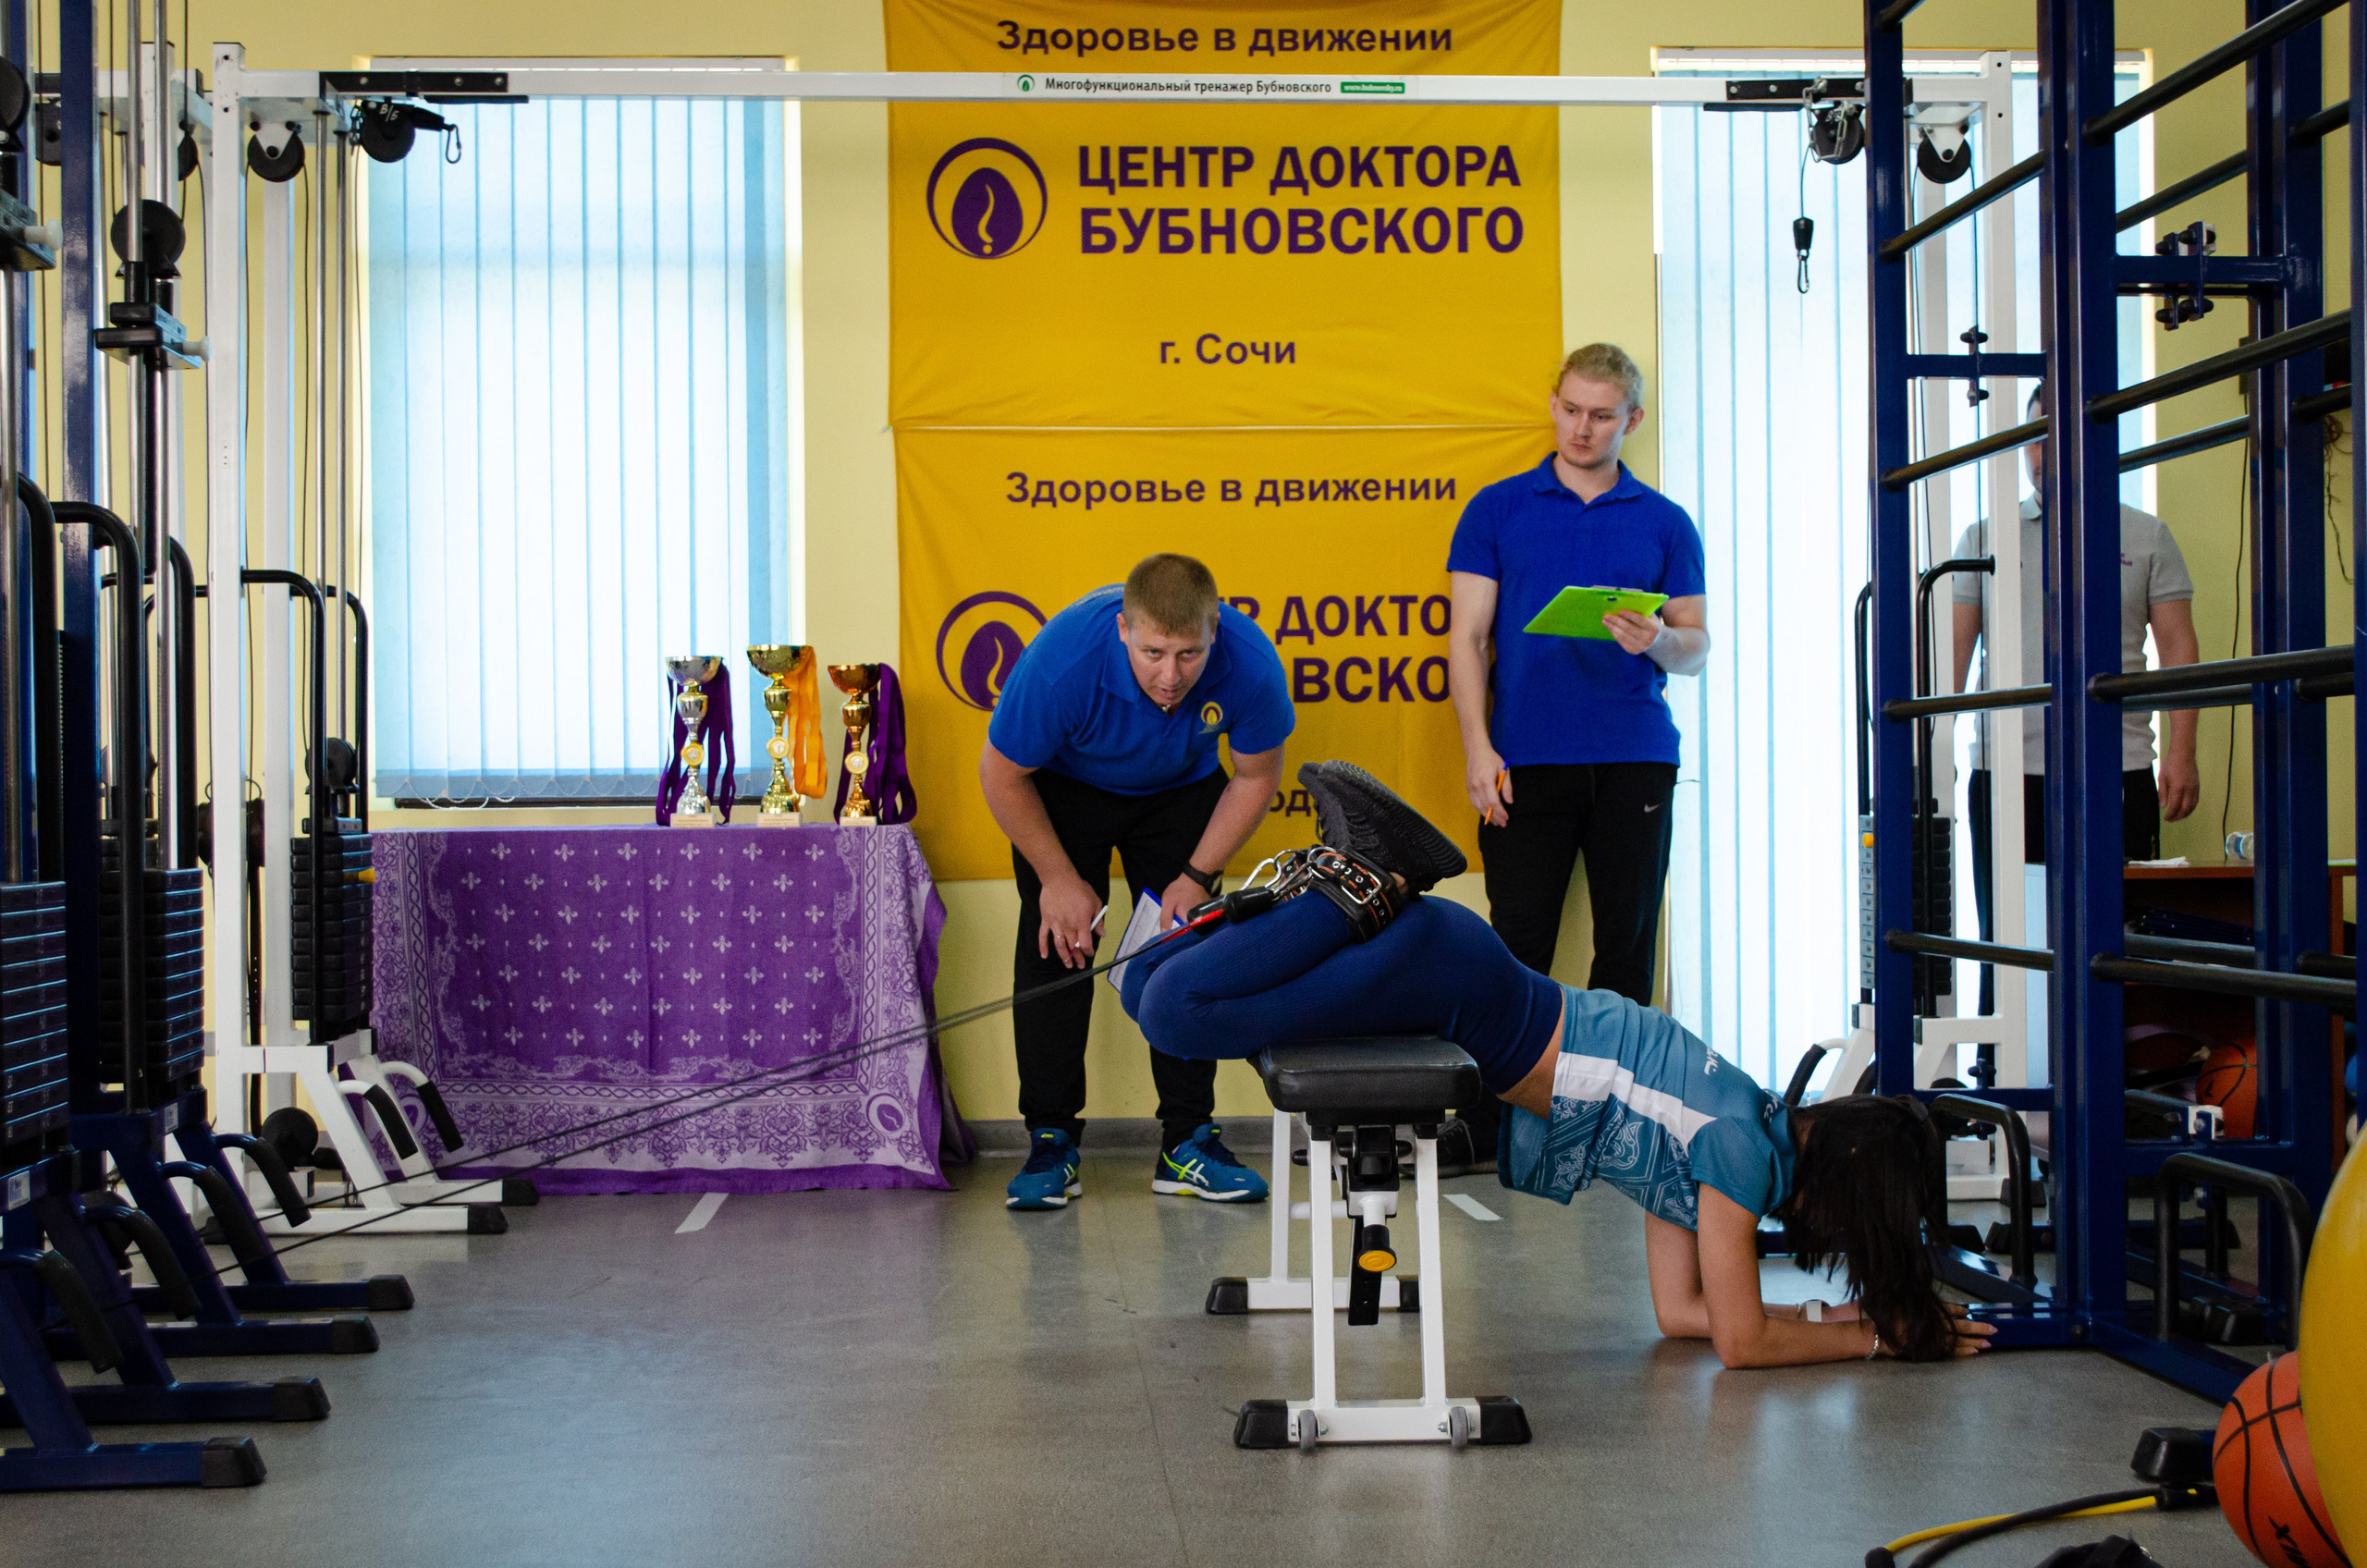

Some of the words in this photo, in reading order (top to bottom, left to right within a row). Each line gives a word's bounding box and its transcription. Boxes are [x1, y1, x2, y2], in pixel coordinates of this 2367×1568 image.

[997, 19, 1199, 57] Здоровье
[1214, 28, 1236, 52] в
[1248, 28, 1452, 56] движении
[1045, 77, 1191, 93] Многофункциональный
[1194, 81, 1254, 95] тренажер
[1256, 80, 1331, 95] Бубновского
[1079, 145, 1255, 196] ЦЕНТР
[1269, 144, 1521, 196] ДОКТОРА
[1080, 206, 1524, 254] БУБНОВСКОГО
[1160, 342, 1180, 363] г.
[1196, 333, 1296, 364] Сочи
[1007, 472, 1205, 510] Здоровье
[1220, 479, 1242, 503] в
[1255, 478, 1455, 507] движении
[1274, 594, 1451, 645] ДОКТО
